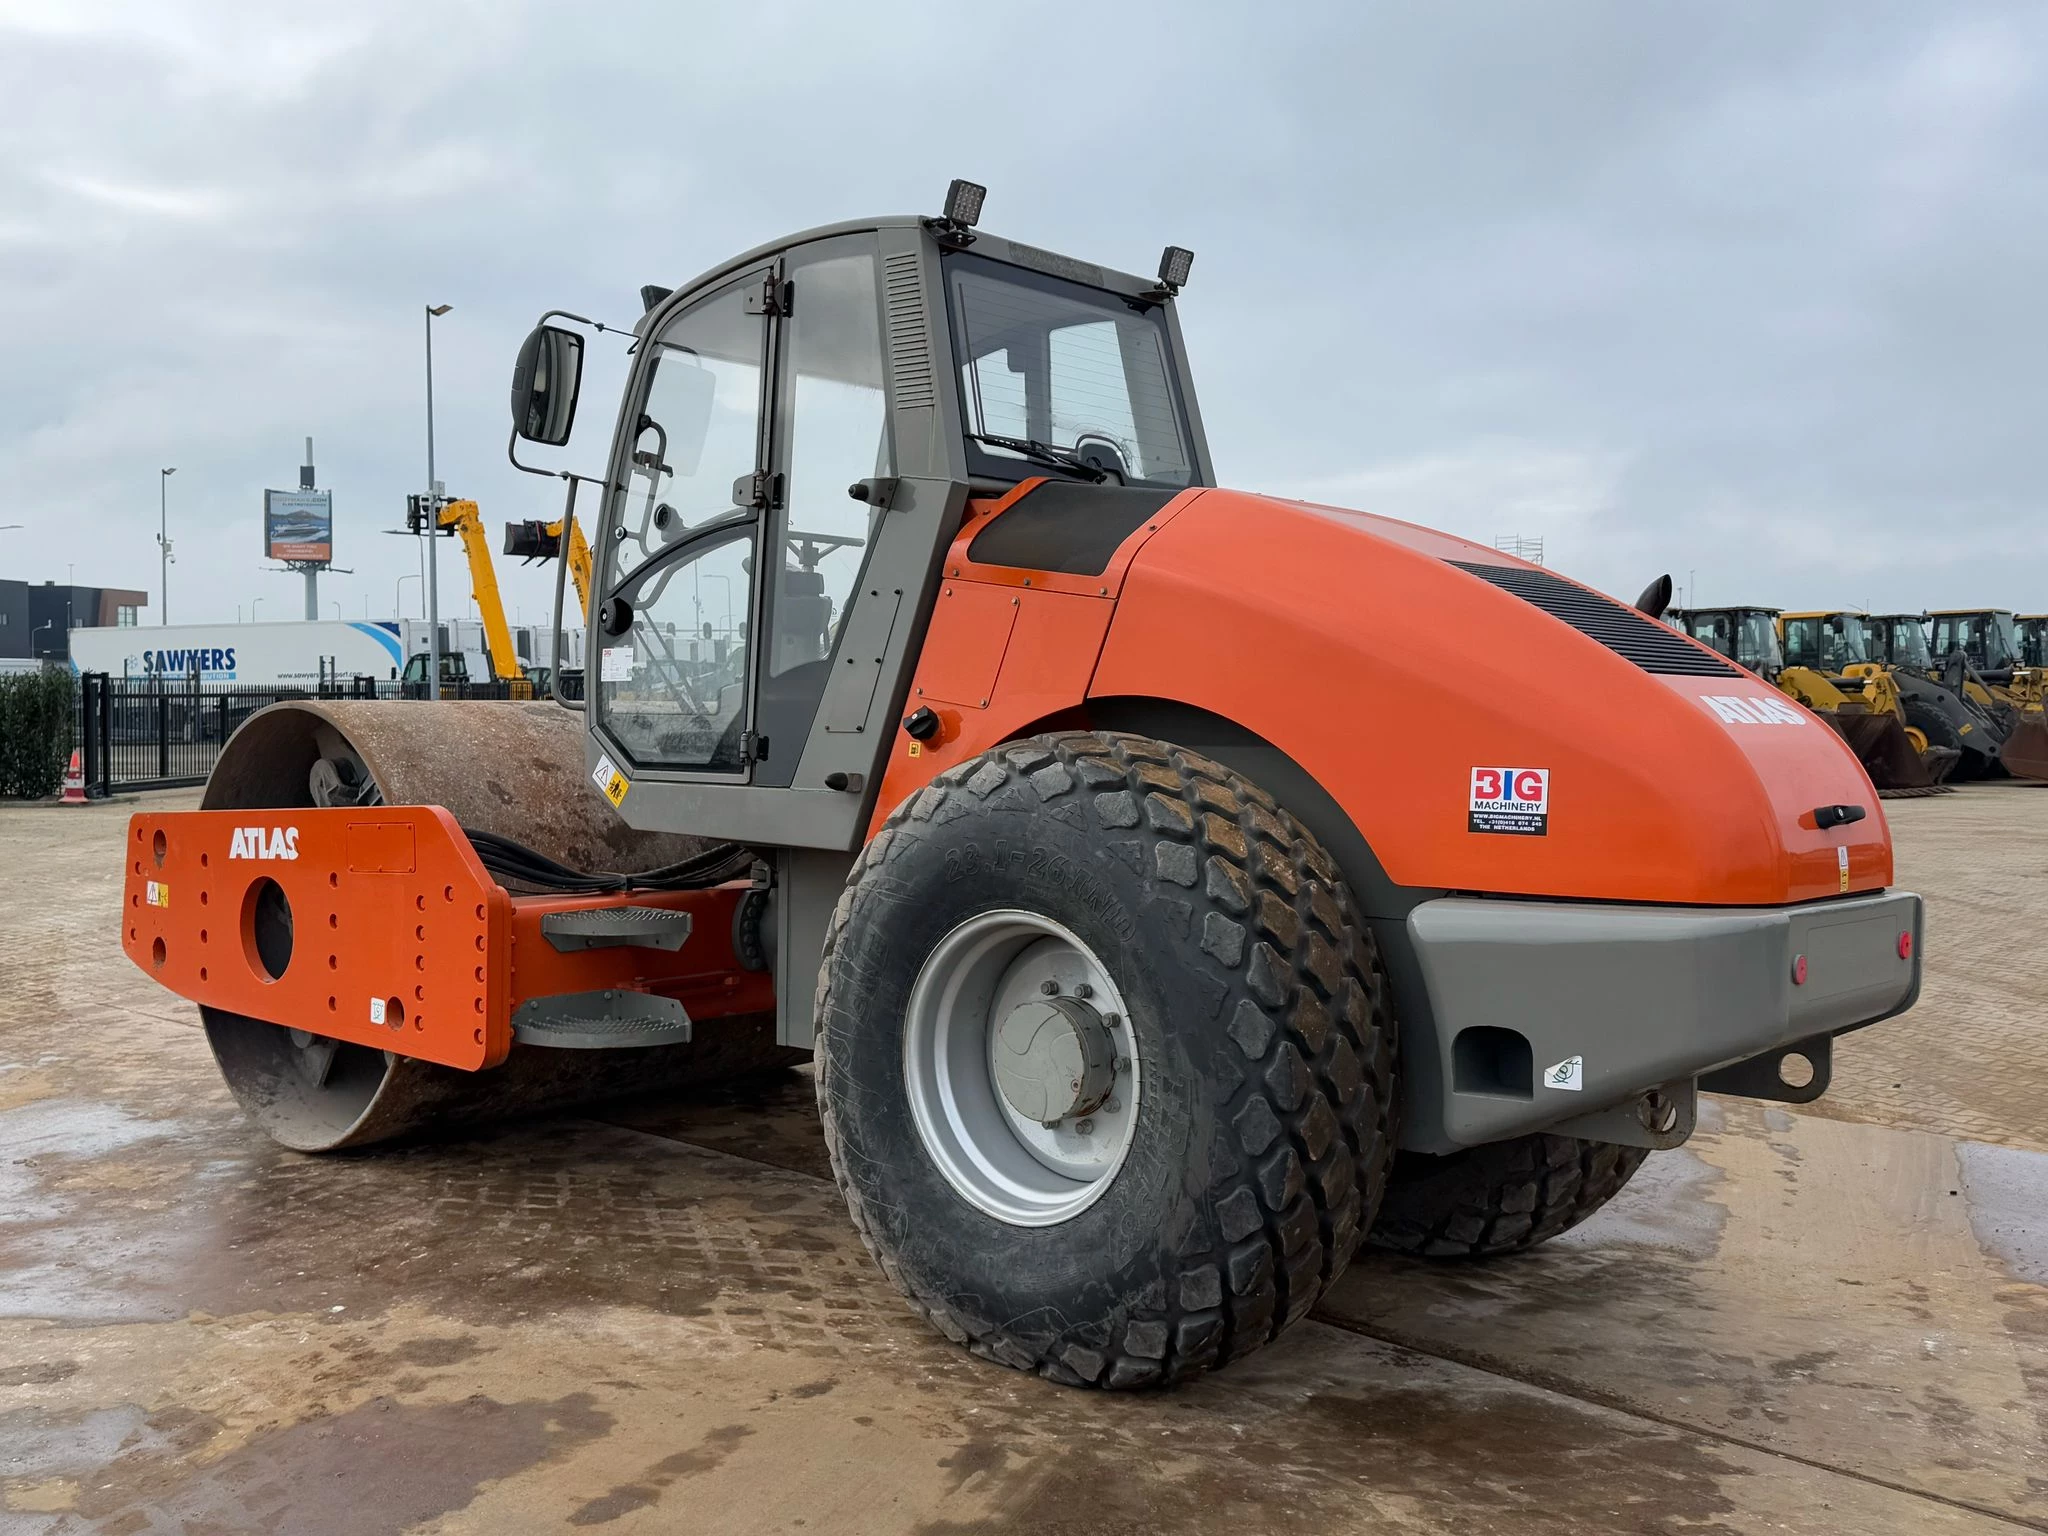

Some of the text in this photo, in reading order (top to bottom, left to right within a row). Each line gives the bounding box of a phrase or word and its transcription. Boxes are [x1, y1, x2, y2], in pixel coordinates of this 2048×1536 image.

[143, 648, 236, 672] SAWYERS
[1699, 695, 1807, 726] ATLAS
[1475, 769, 1543, 801] BIG
[1474, 801, 1542, 812] MACHINERY
[229, 826, 300, 860] ATLAS
